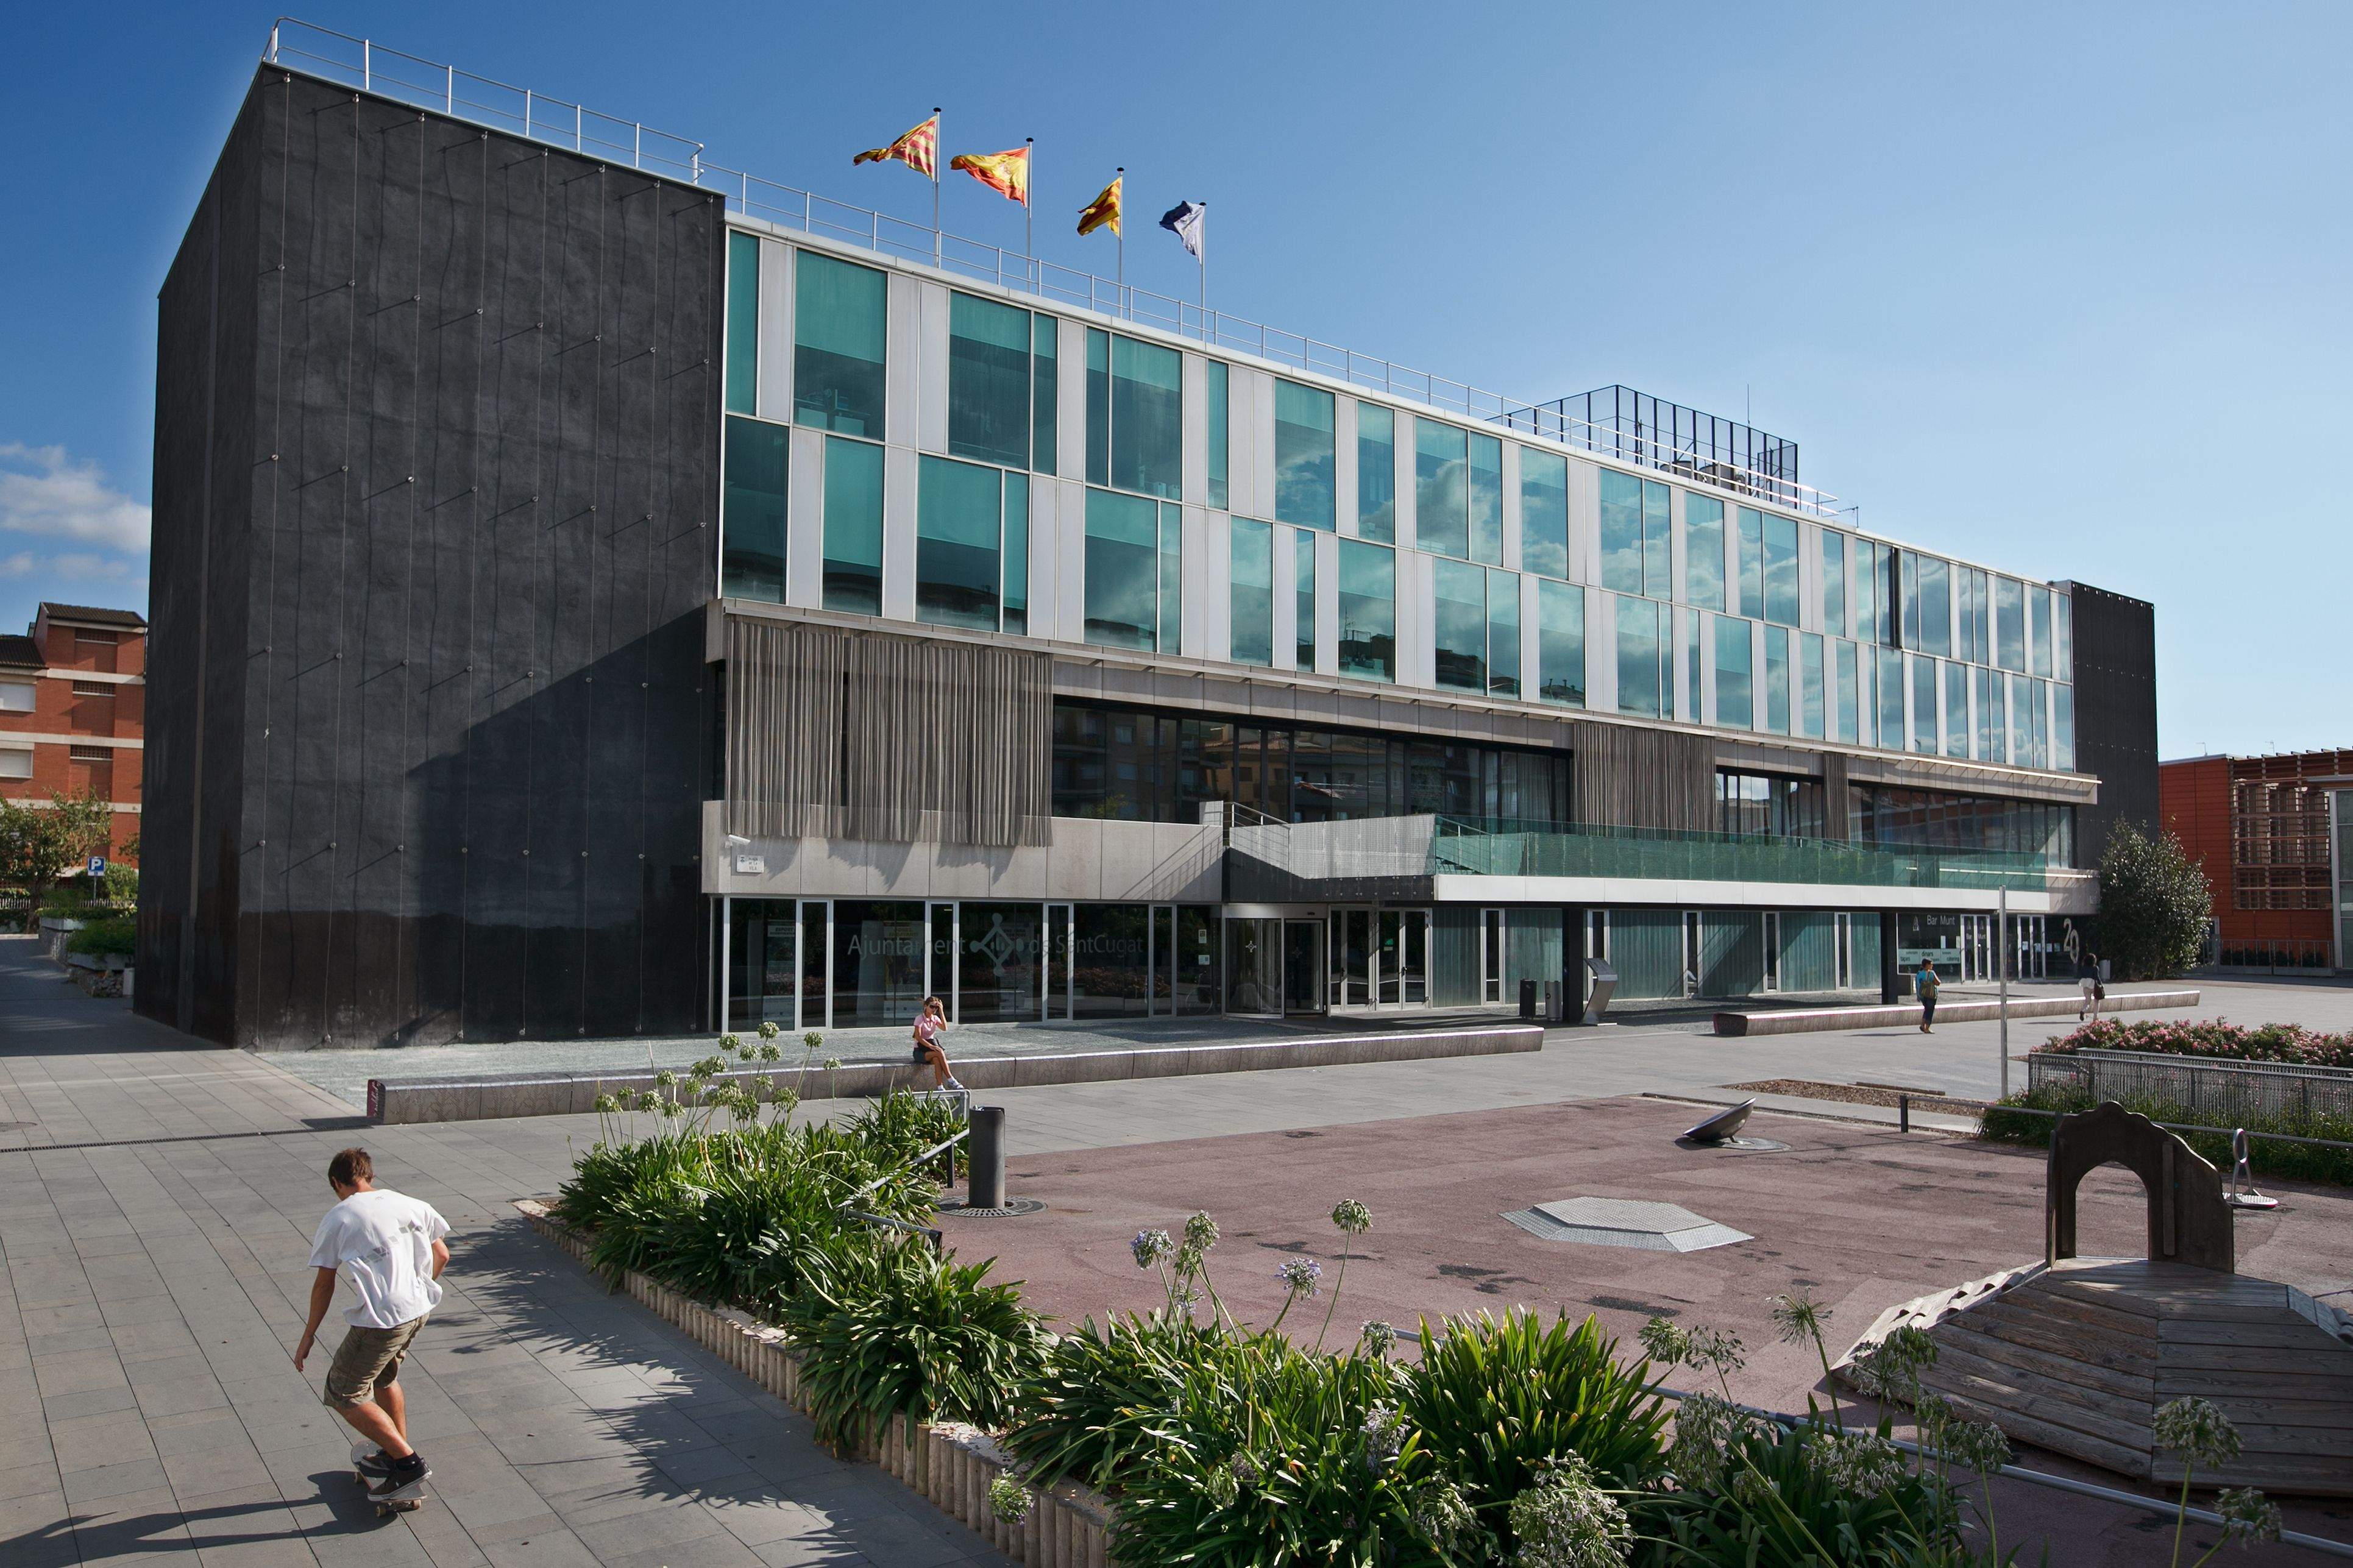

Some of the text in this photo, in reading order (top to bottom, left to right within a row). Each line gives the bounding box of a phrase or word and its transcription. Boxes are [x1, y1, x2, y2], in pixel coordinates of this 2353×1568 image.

[91, 859, 102, 870] P
[1926, 914, 1955, 925] Bar Munt
